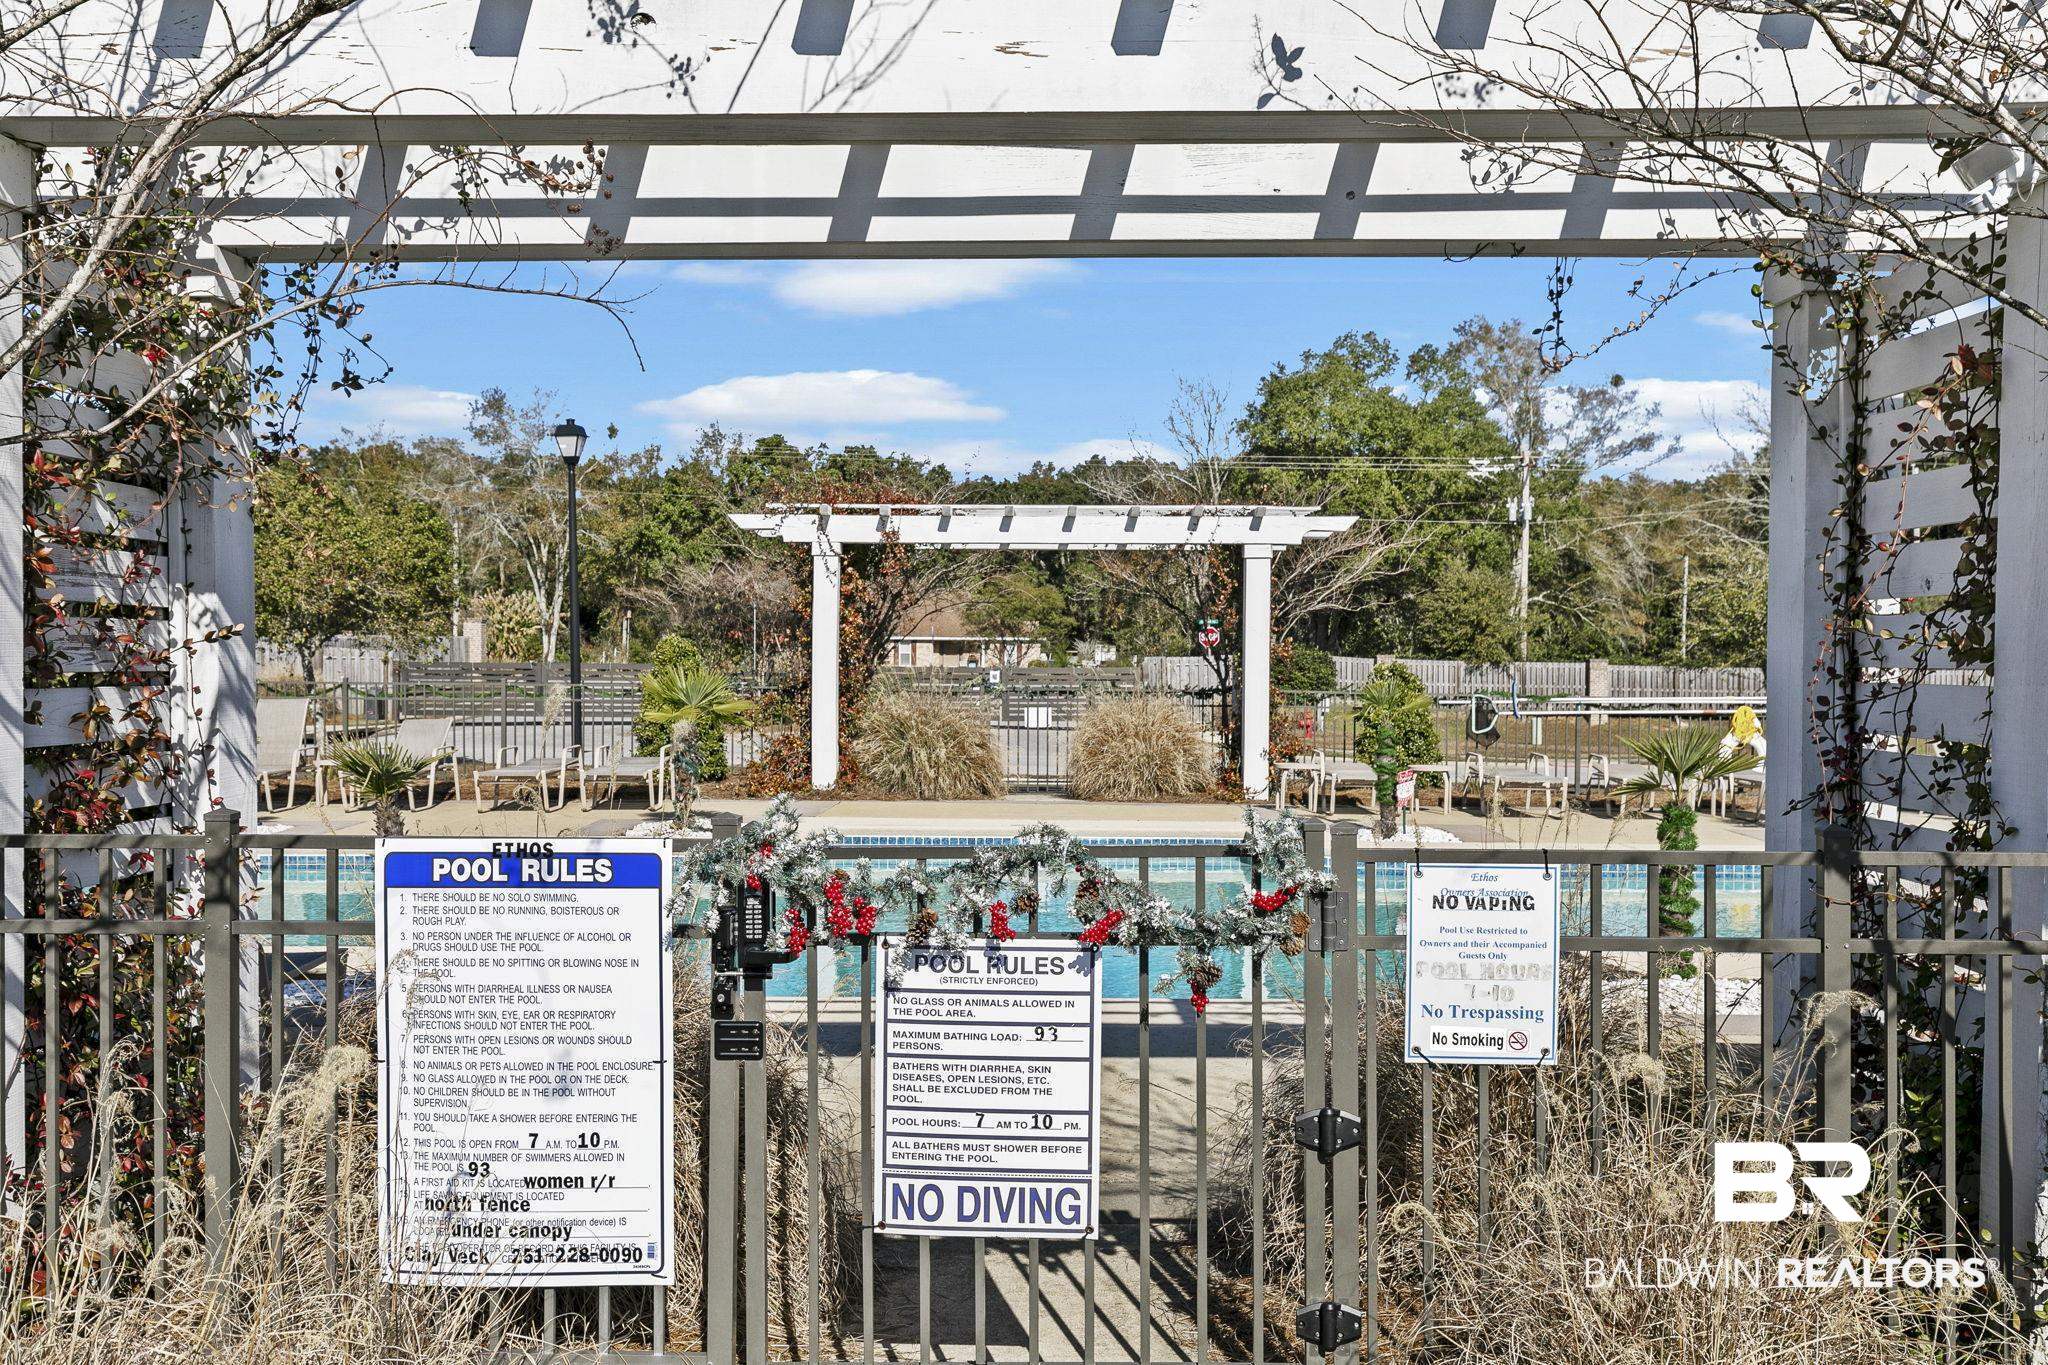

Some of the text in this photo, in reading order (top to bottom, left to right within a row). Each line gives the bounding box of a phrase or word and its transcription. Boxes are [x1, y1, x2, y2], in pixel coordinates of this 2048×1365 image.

[492, 843, 555, 858] ETHOS
[432, 858, 613, 882] POOL RULES
[1471, 872, 1498, 881] Ethos
[400, 893, 578, 902] 1. THERE SHOULD BE NO SOLO SWIMMING.
[1432, 895, 1459, 909] NO
[400, 906, 619, 916] 2. THERE SHOULD BE NO RUNNING, BOISTEROUS OR
[412, 916, 466, 926] ROUGH PLAY.
[1475, 926, 1517, 934] Restricted
[400, 932, 631, 942] 3. NO PERSON UNDER THE INFLUENCE OF ALCOHOL OR
[412, 942, 543, 952] DRUGS SHOULD USE THE POOL.
[1420, 939, 1452, 948] Owners
[1492, 941, 1547, 950] Accompanied
[1487, 952, 1507, 961] Only
[914, 955, 1064, 976] POOL RULES
[939, 976, 1038, 987] (STRICTLY ENFORCED)
[893, 996, 1074, 1008] NO GLASS OR ANIMALS ALLOWED IN
[892, 1007, 975, 1017] THE POOL AREA.
[1421, 1004, 1543, 1023] No Trespassing
[892, 1026, 1058, 1042] MAXIMUM BATHING LOAD: 93
[413, 1035, 632, 1045] PERSONS WITH OPEN LESIONS OR WOUNDS SHOULD
[1432, 1032, 1503, 1050] No Smoking
[413, 1046, 505, 1056] NOT ENTER THE POOL.
[892, 1042, 942, 1051] PERSONS.
[413, 1061, 655, 1071] NO ANIMALS OR PETS ALLOWED IN THE POOL ENCLOSURE.
[892, 1063, 1051, 1074] BATHERS WITH DIARRHEA, SKIN
[892, 1074, 1049, 1085] DISEASES, OPEN LESIONS, ETC.
[892, 1084, 1052, 1096] SHALL BE EXCLUDED FROM THE
[413, 1098, 468, 1108] SUPERVISION.
[892, 1095, 922, 1104] POOL.
[892, 1112, 1081, 1130] POOL HOURS: 7 AM TO 10 PM.
[414, 1132, 619, 1149] THIS POOL IS OPEN FROM 7 A.M. TO 10 P.M.
[892, 1141, 1081, 1154] ALL BATHERS MUST SHOWER BEFORE
[892, 1152, 997, 1163] ENTERING THE POOL.
[468, 1162, 490, 1177] 93
[523, 1174, 615, 1193] women r/r
[425, 1195, 530, 1211] north fence
[892, 1183, 1081, 1225] NO DIVING
[452, 1222, 572, 1241] under canopy
